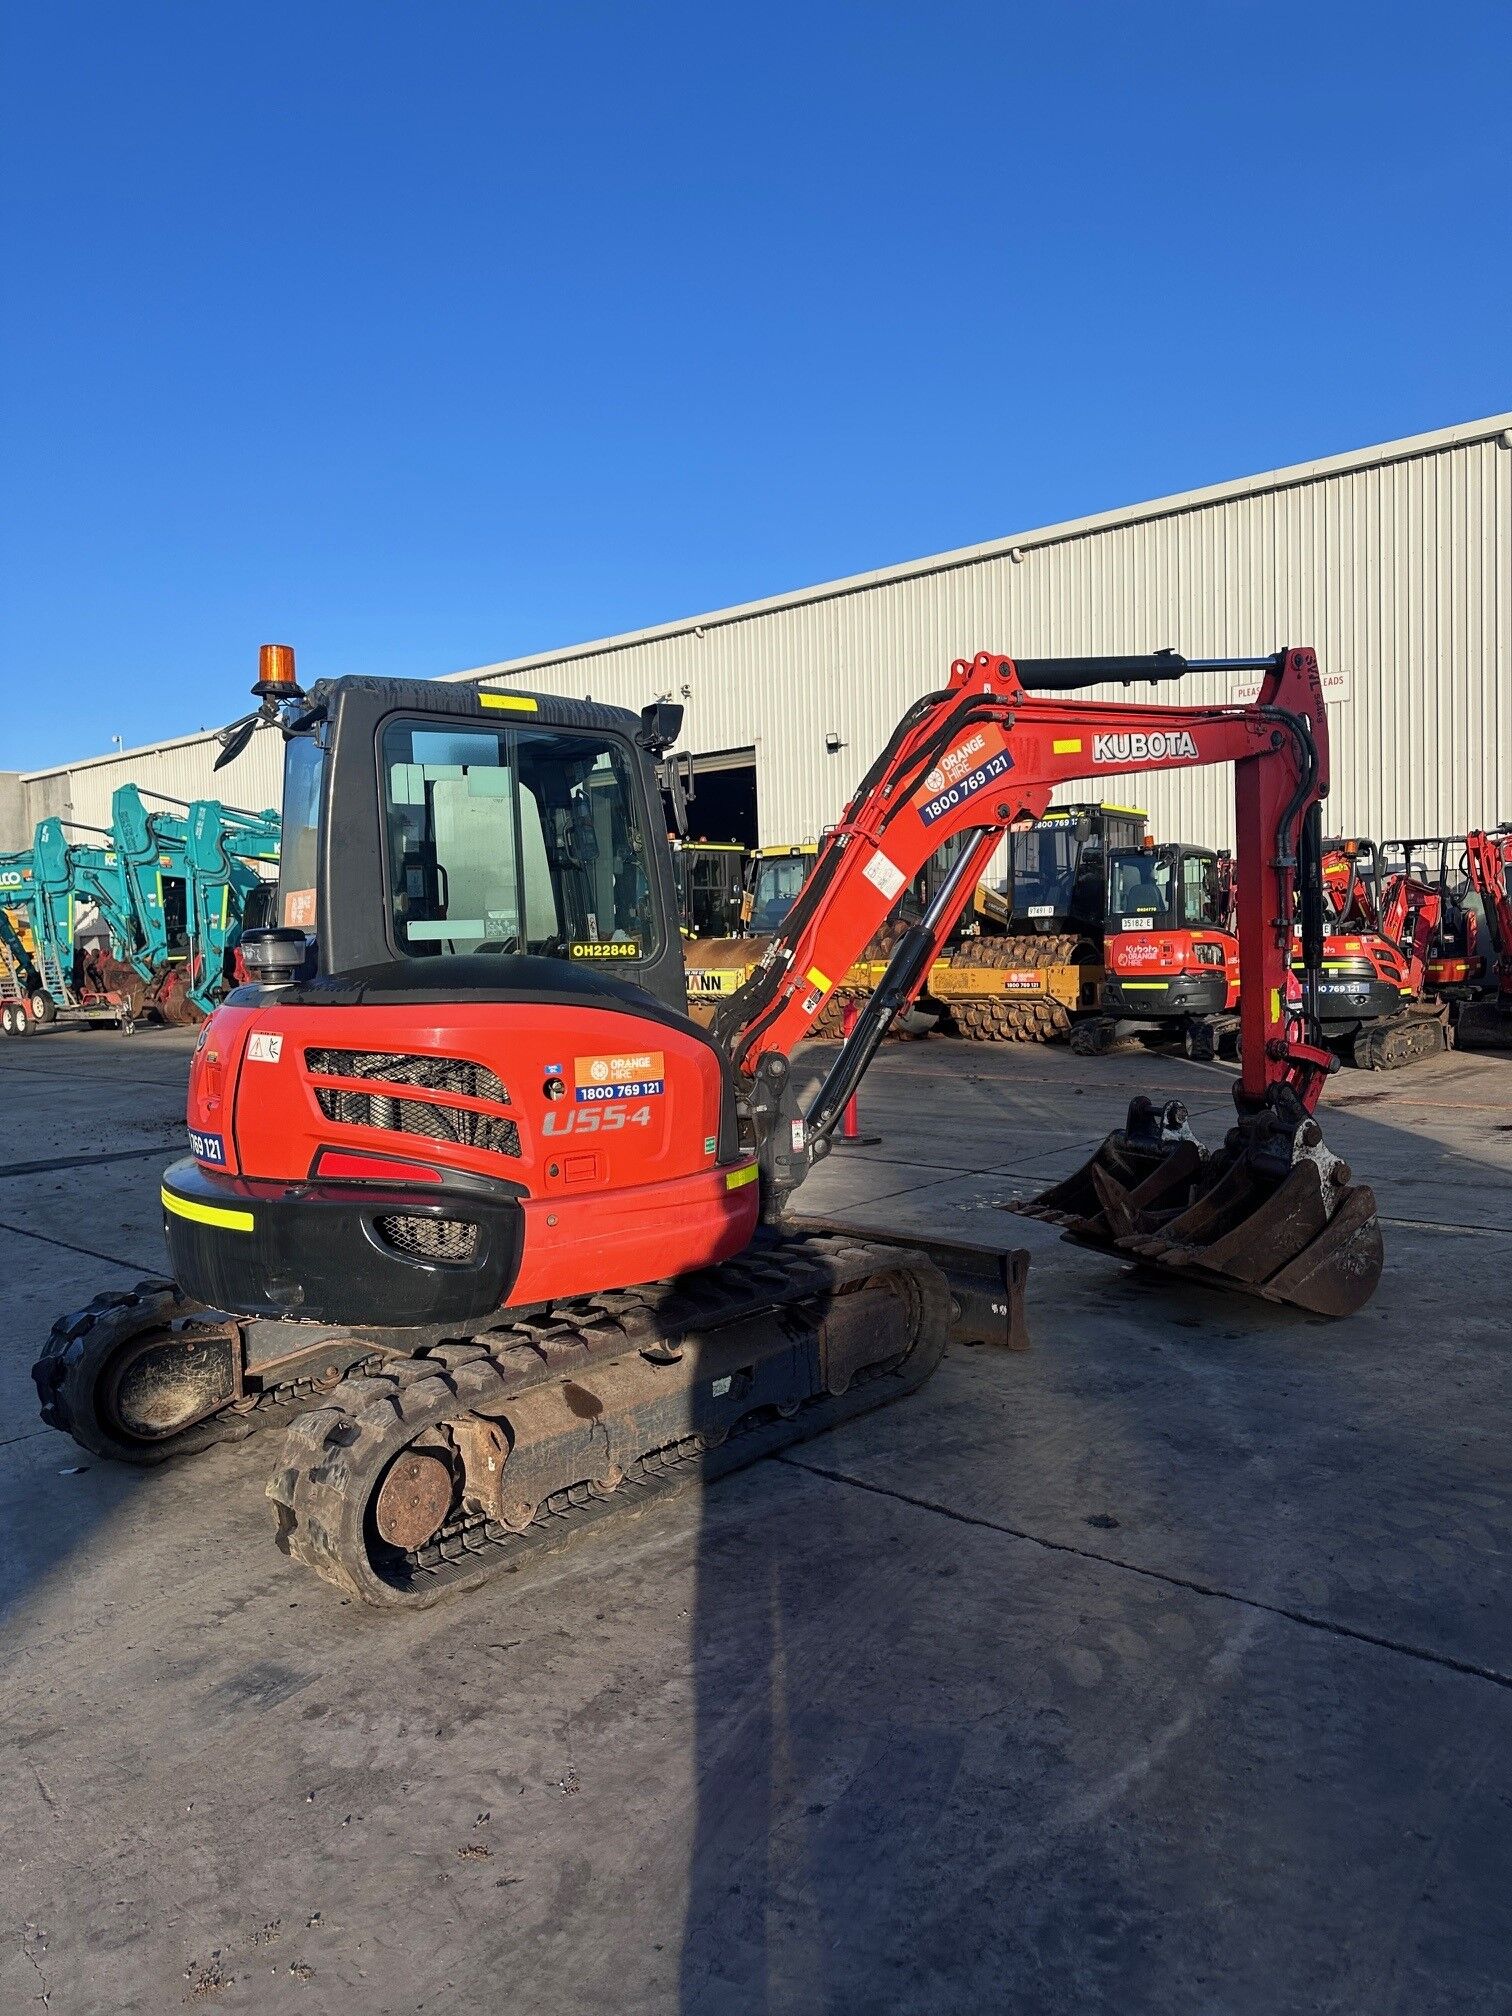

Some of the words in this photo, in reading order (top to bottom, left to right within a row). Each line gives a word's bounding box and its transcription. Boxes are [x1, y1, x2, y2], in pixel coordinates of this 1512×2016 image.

[1238, 687, 1261, 698] PLEAS
[1324, 676, 1344, 686] EADS
[941, 733, 986, 771] ORANGE
[1093, 731, 1197, 760] KUBOTA
[947, 759, 973, 782] HIRE
[925, 790, 959, 819] 1800
[960, 770, 986, 796] 769
[986, 755, 1008, 776] 121
[1055, 819, 1070, 827] 769
[573, 944, 636, 957] OH22846
[1125, 945, 1158, 953] Kubota
[1328, 985, 1346, 993] 769
[1347, 985, 1360, 993] 121
[610, 1056, 652, 1069] ORANGE
[610, 1069, 633, 1080] HIRE
[581, 1087, 614, 1101] 1800
[617, 1084, 640, 1097] 769
[643, 1082, 660, 1095] 121
[204, 1138, 222, 1160] 121
